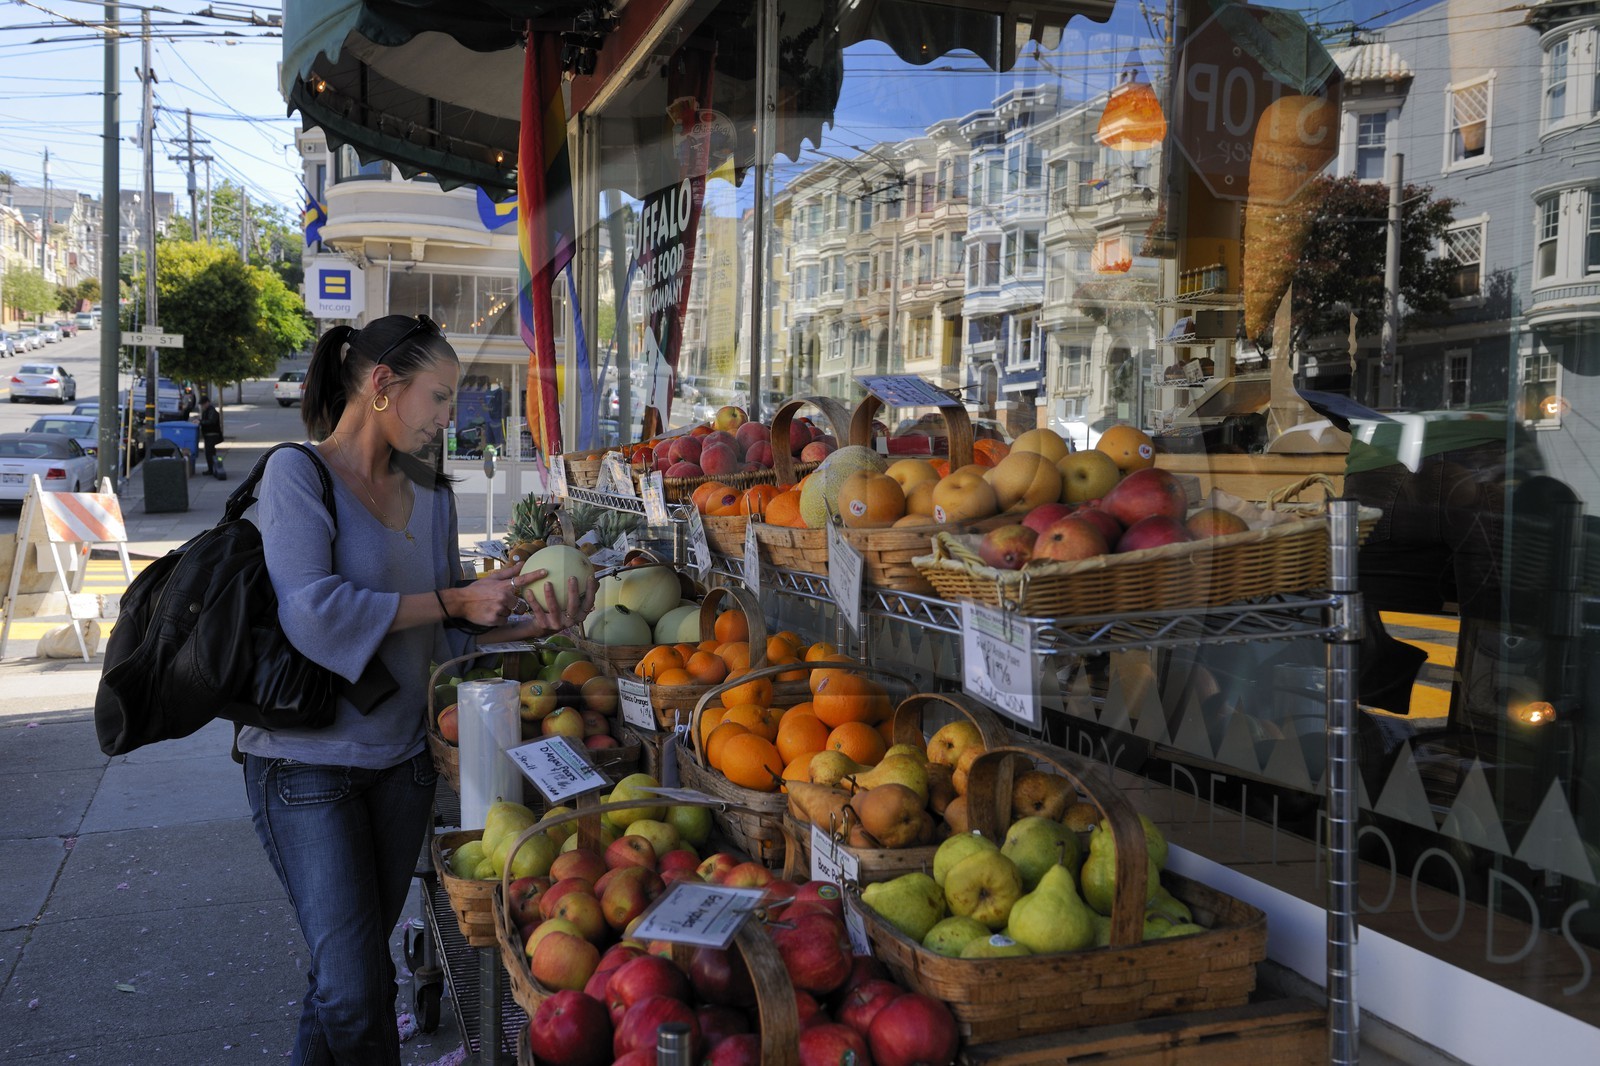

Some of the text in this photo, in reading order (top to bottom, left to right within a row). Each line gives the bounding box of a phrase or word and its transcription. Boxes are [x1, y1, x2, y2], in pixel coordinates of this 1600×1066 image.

[632, 177, 692, 261] UFFALO
[658, 243, 685, 282] FOOD
[319, 302, 351, 314] hrc.org
[650, 276, 684, 314] COMPANY
[160, 336, 175, 345] ST
[556, 765, 579, 782] Pears
